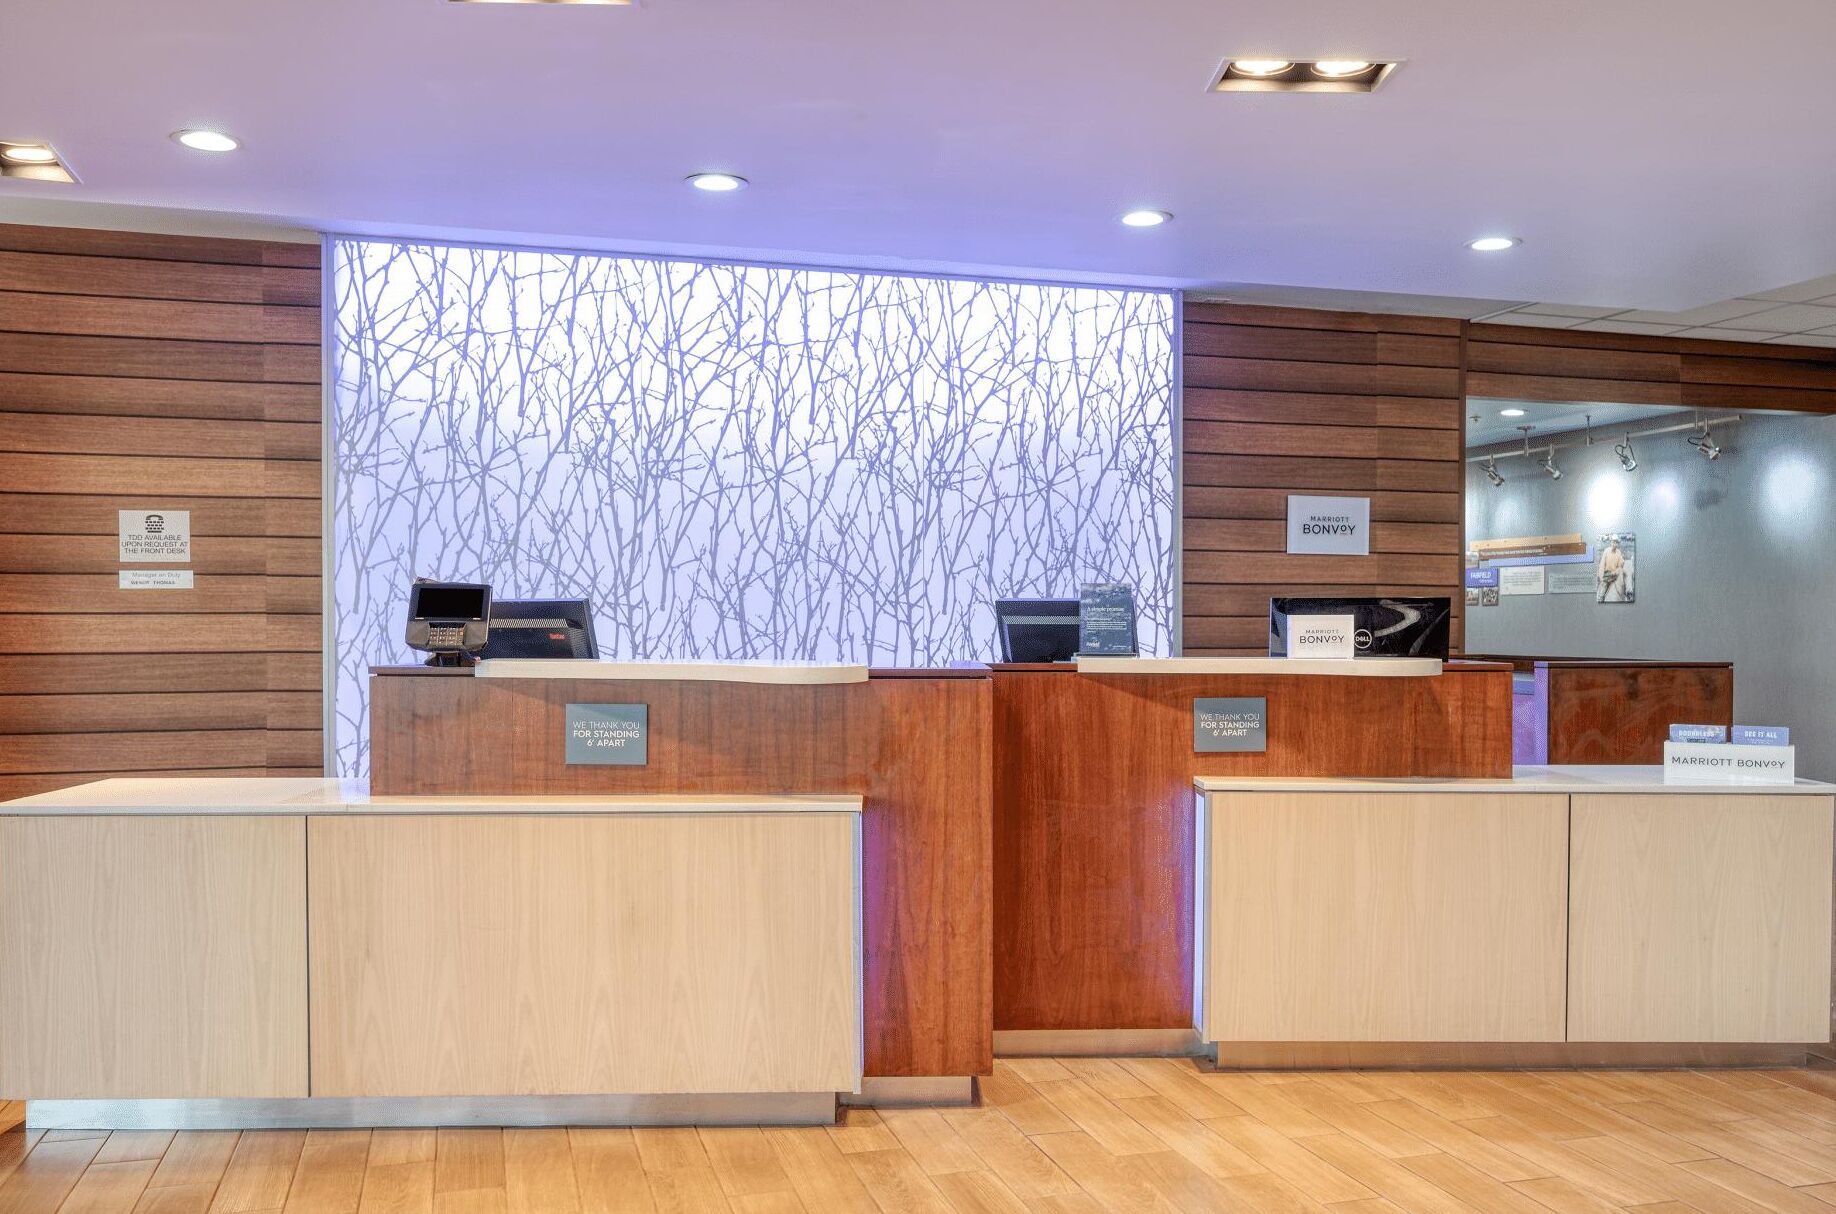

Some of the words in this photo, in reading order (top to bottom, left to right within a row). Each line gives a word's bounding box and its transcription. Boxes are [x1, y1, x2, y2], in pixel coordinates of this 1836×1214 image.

[1303, 524, 1356, 535] BONVOY
[572, 721, 586, 729] WE
[590, 721, 619, 729] THANK
[621, 721, 640, 729] YOU
[1200, 721, 1217, 729] FOR
[1219, 721, 1260, 729] STANDING
[573, 730, 592, 738] FOR
[593, 730, 640, 738] STANDING
[1221, 729, 1248, 737] APART
[587, 739, 595, 747] 6'
[596, 739, 626, 747] APART
[1671, 756, 1733, 767] MARRIOTT
[1737, 759, 1786, 769] BONVOY
